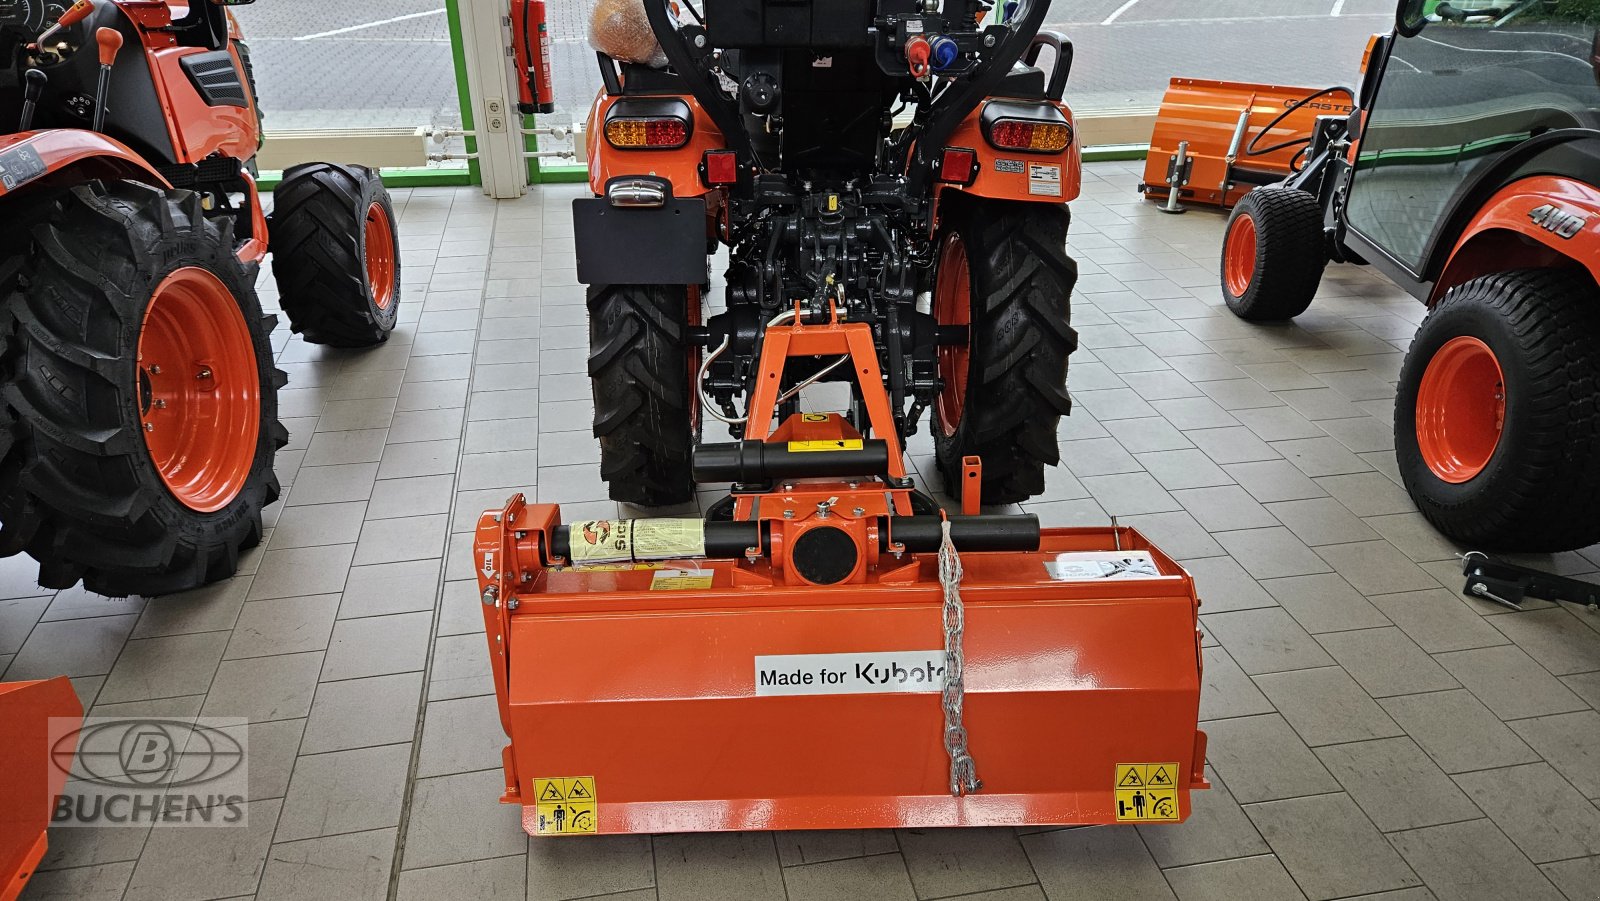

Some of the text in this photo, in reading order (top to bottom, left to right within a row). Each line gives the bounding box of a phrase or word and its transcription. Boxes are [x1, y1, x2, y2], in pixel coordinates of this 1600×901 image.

[1528, 204, 1586, 239] 4WD
[760, 669, 813, 686] Made
[820, 669, 847, 684] for
